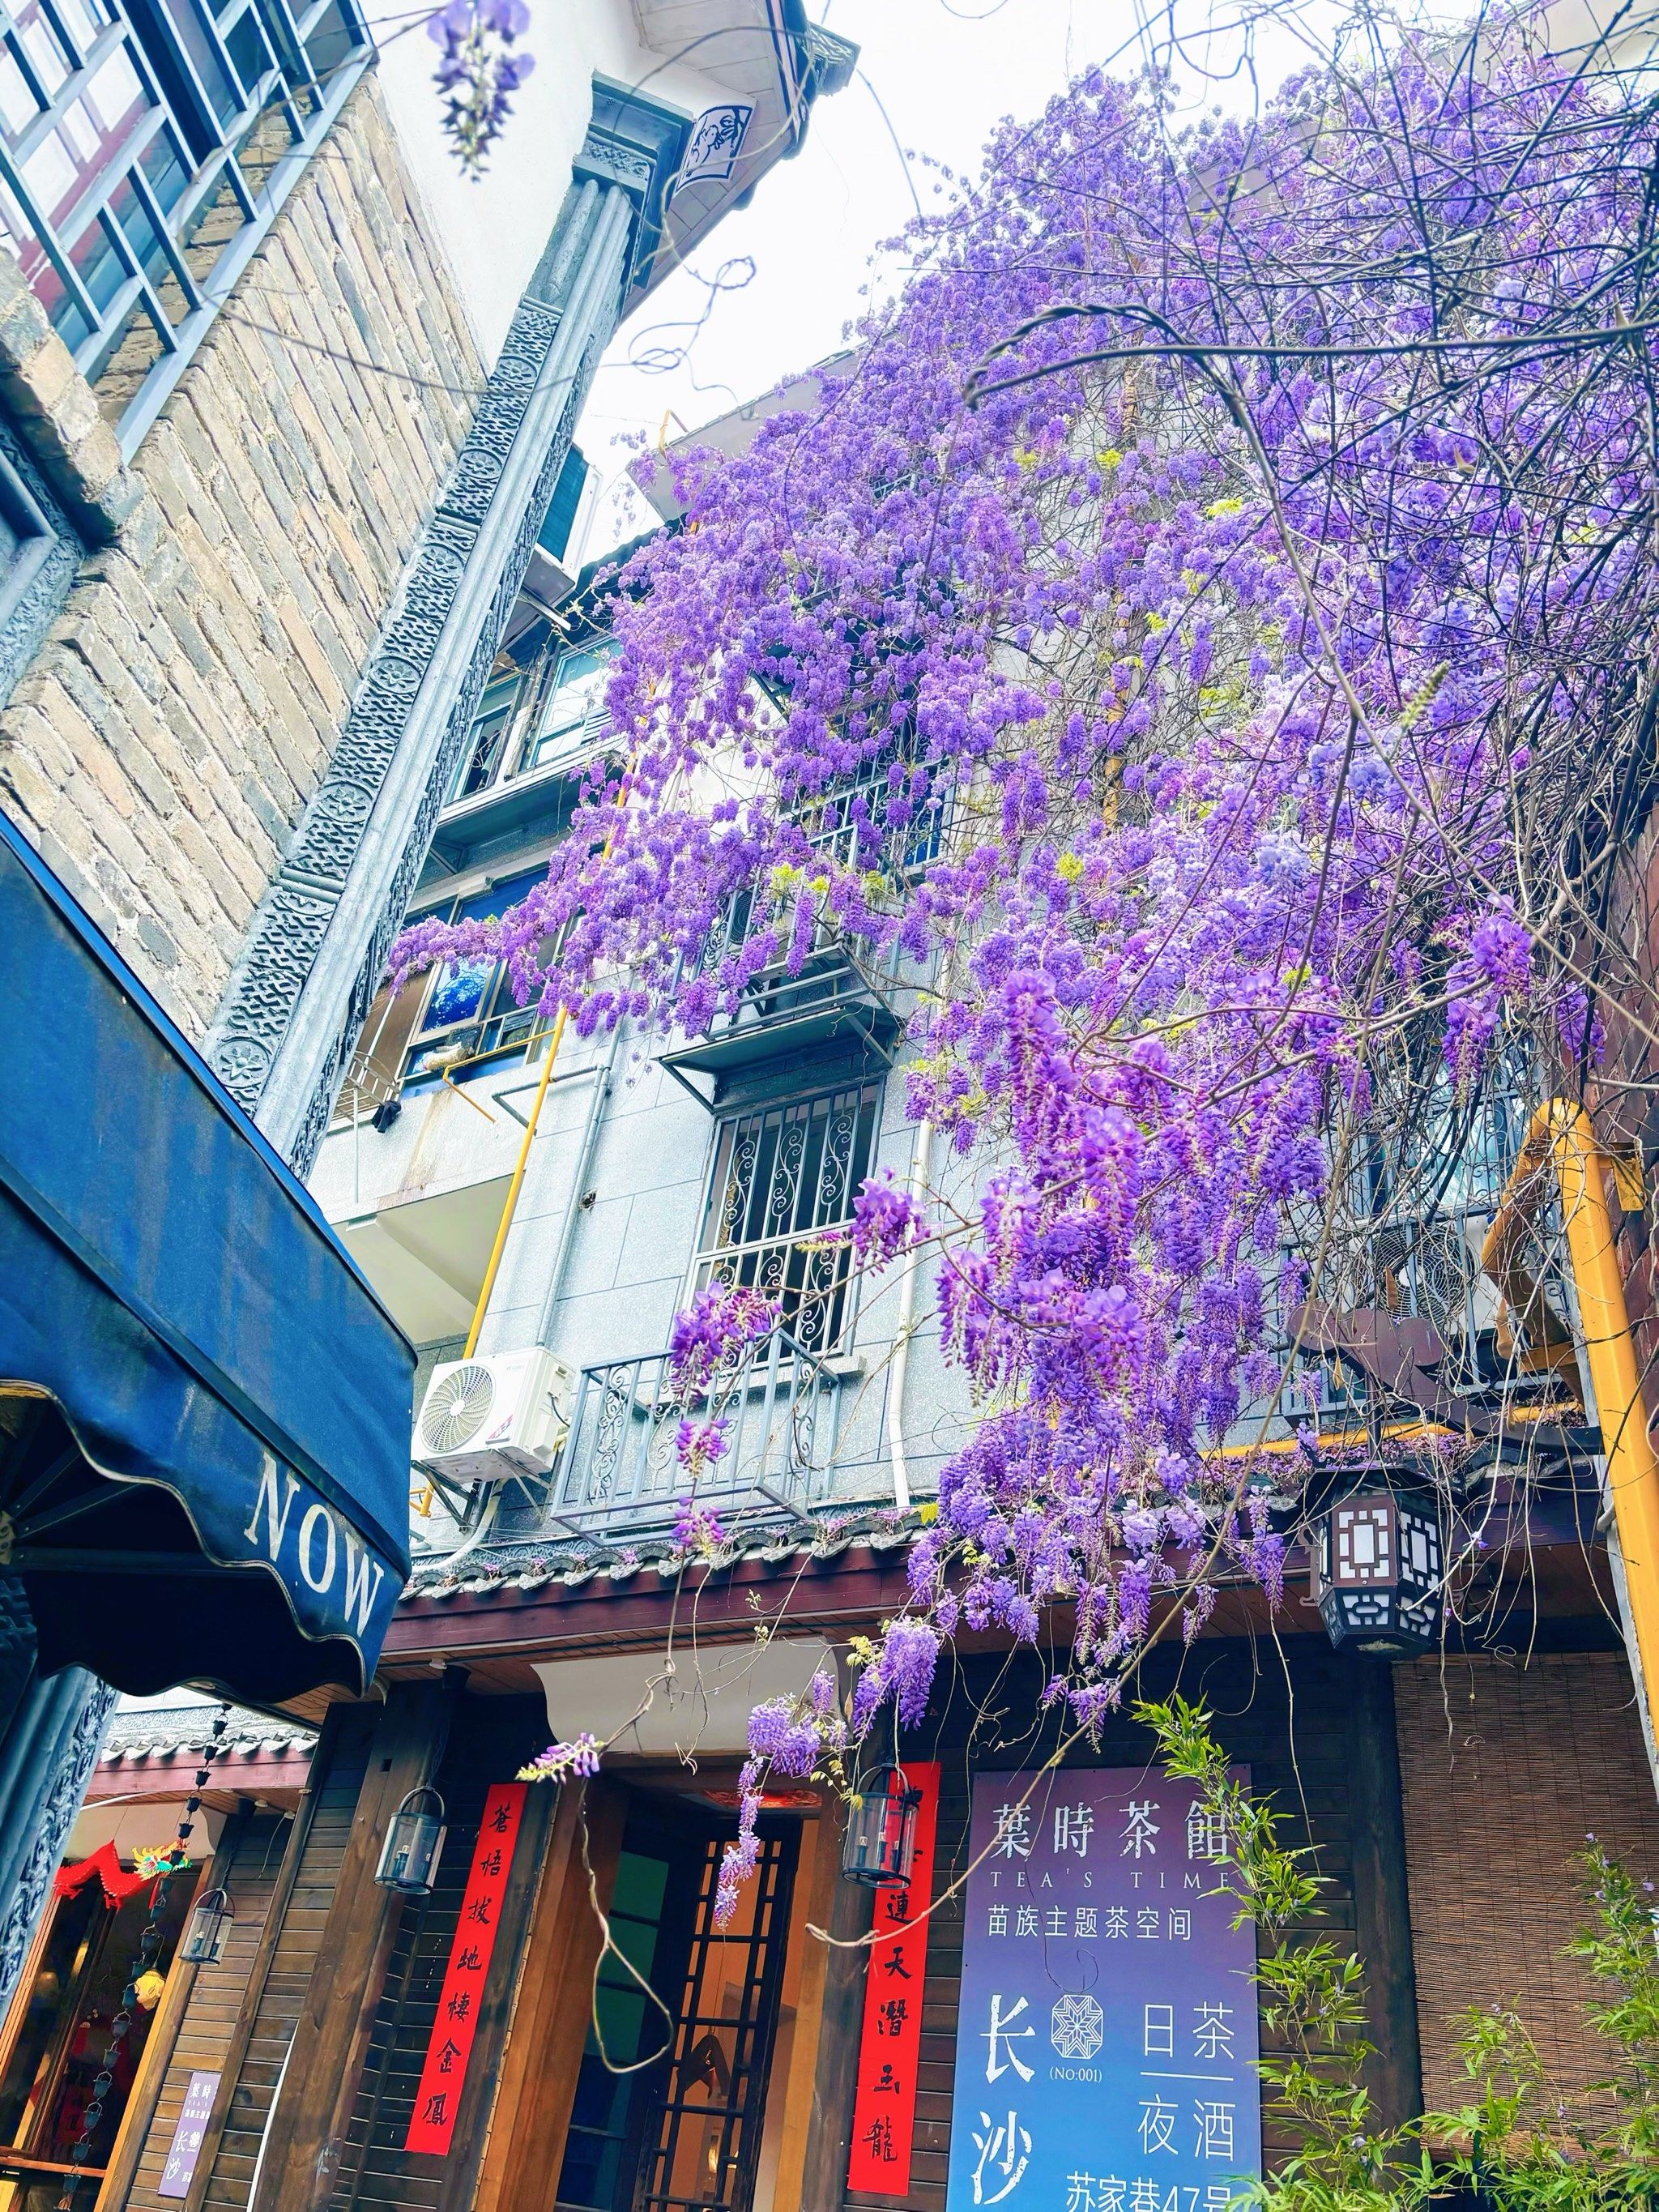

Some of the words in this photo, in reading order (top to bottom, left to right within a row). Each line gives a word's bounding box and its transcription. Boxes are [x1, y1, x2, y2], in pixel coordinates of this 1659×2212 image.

[244, 1452, 384, 1638] NOW
[990, 1800, 1228, 1860] 葉時茶館
[990, 1868, 1093, 1889] TEA'S
[1130, 1871, 1229, 1890] TIME
[987, 1903, 1192, 1941] 苗族主题茶空间
[970, 1994, 1037, 2205] 长沙
